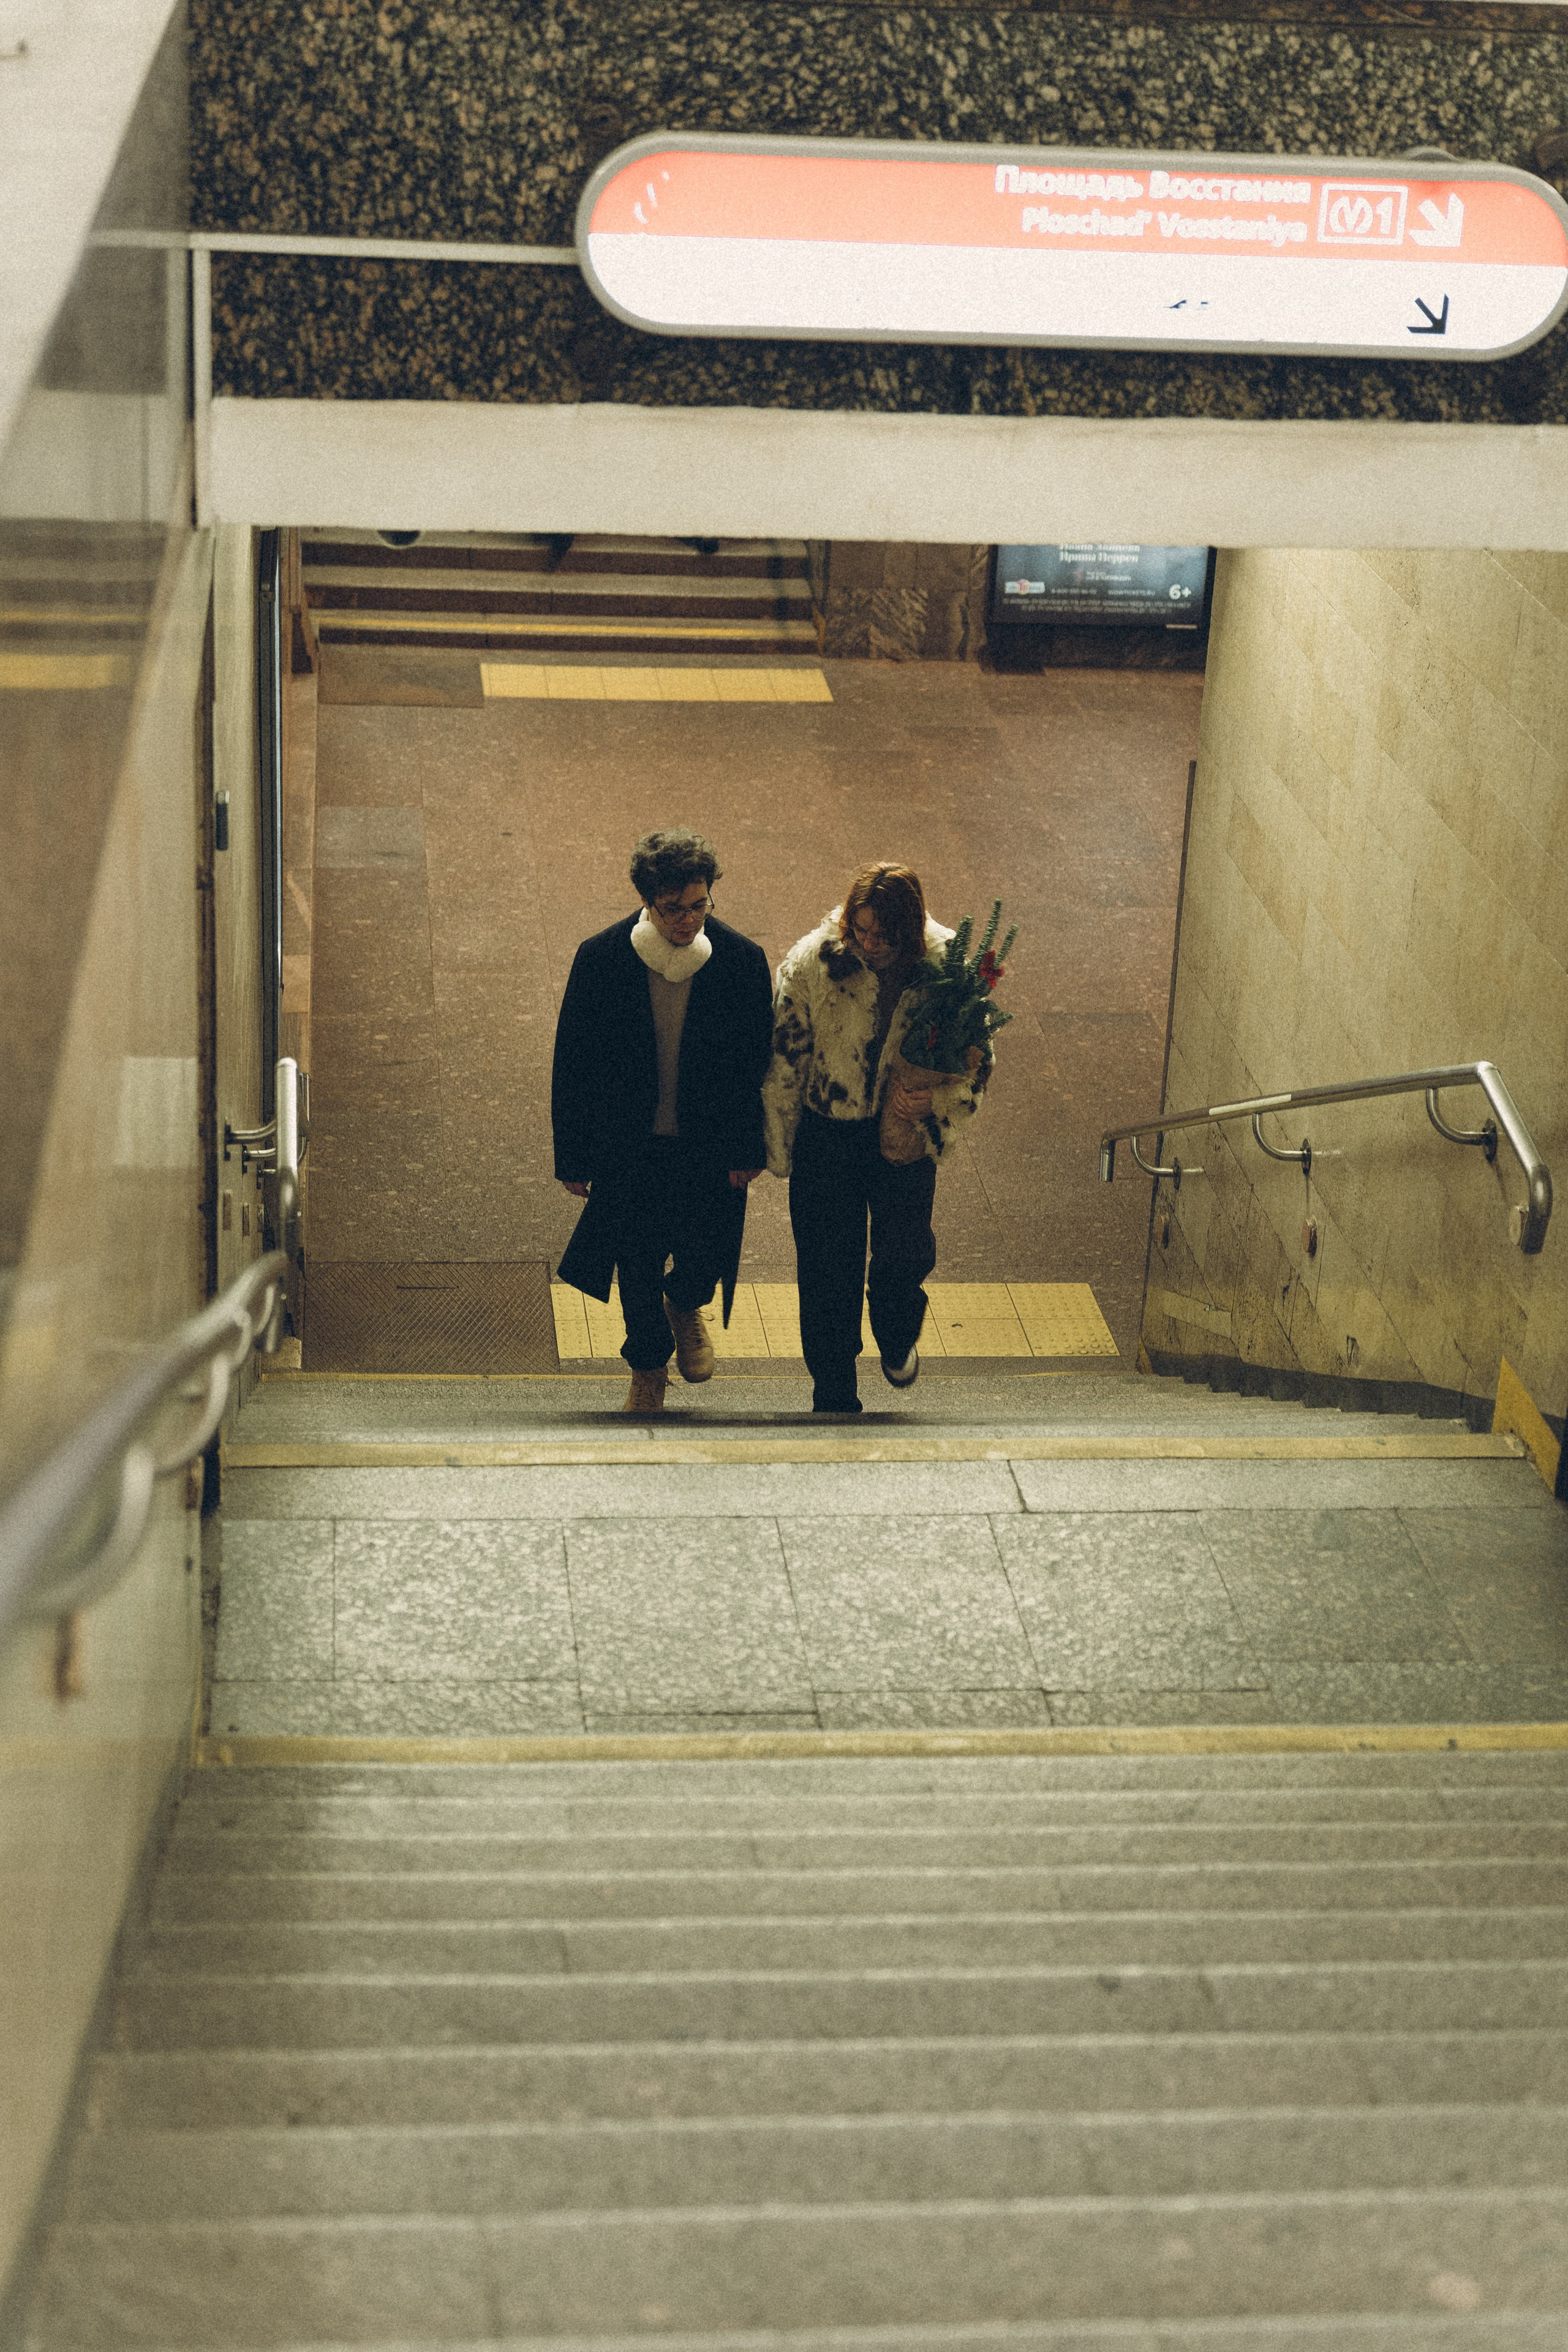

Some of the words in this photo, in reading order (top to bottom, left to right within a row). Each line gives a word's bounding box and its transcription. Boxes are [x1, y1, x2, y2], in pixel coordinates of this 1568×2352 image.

[994, 164, 1144, 202] Площадь
[1148, 170, 1312, 205] Восстания
[1158, 211, 1308, 247] Vosstaniya
[1169, 584, 1192, 600] 6+
